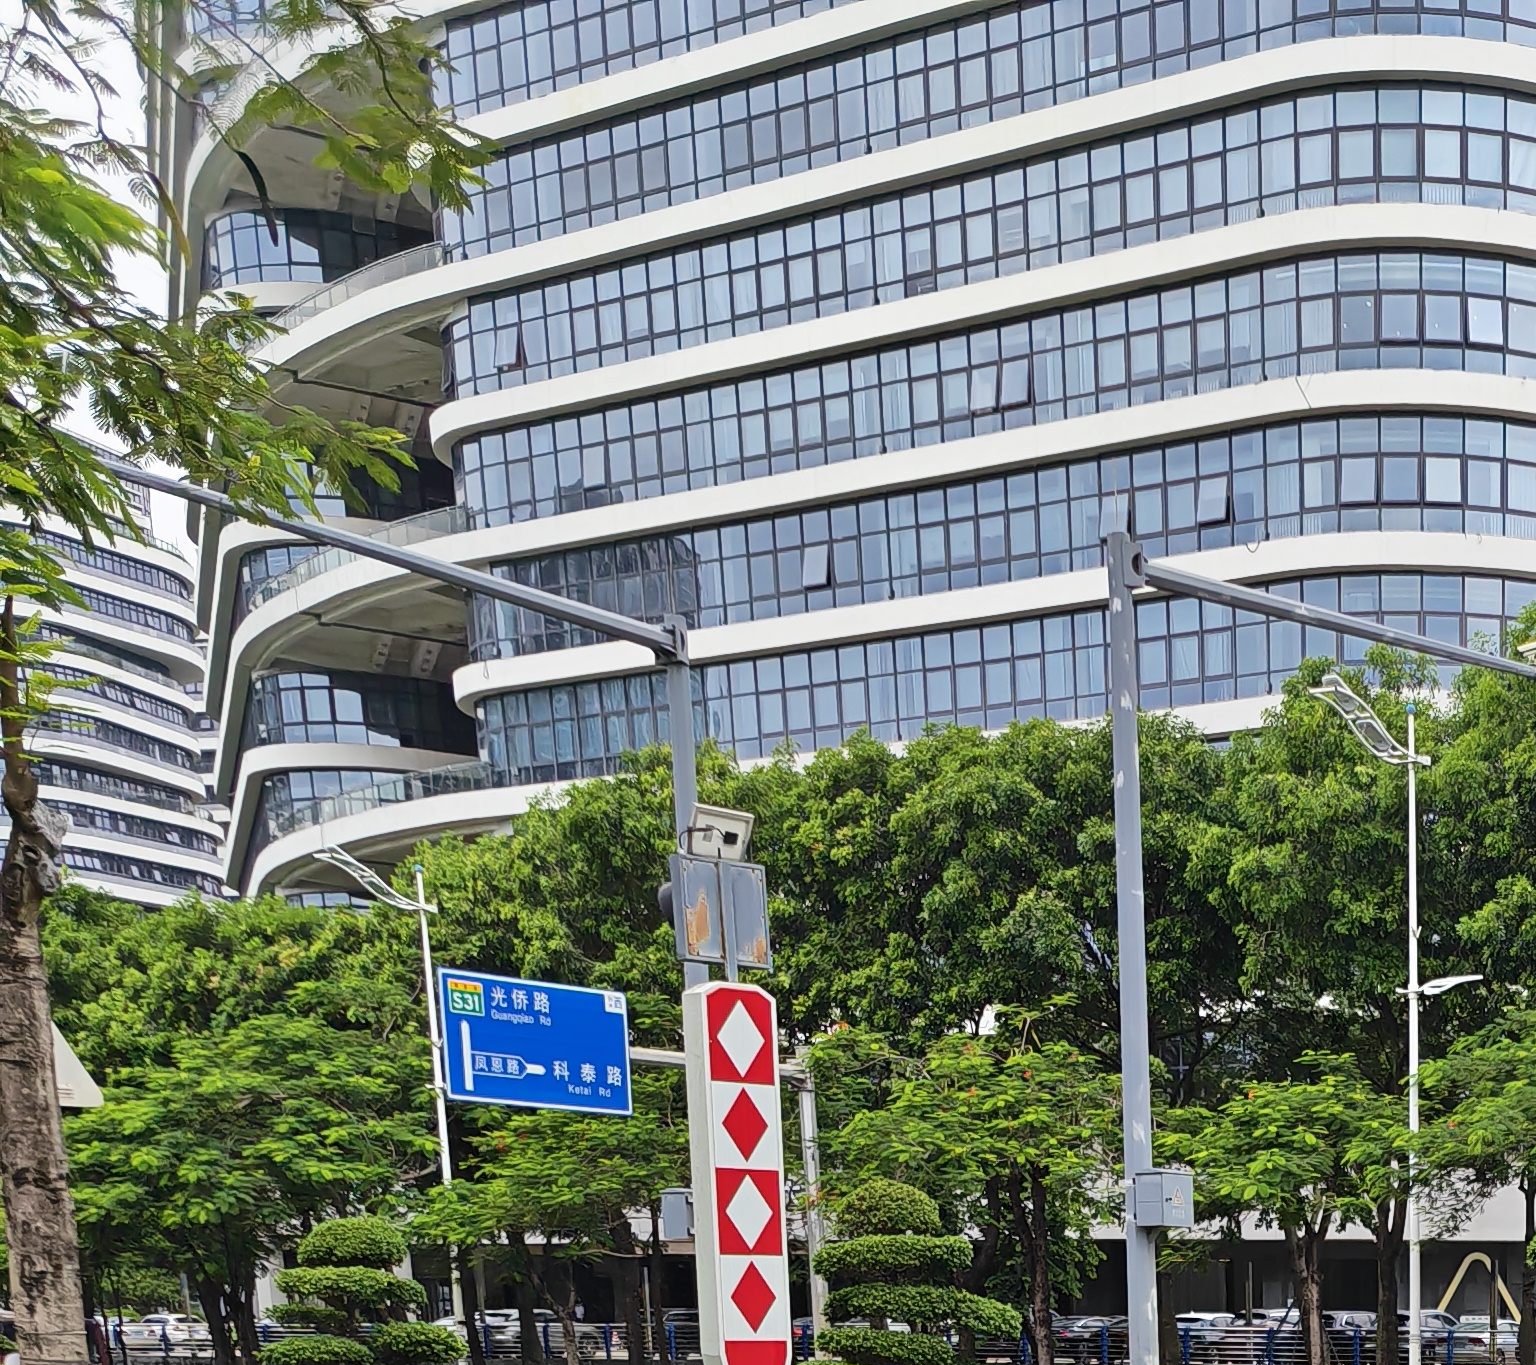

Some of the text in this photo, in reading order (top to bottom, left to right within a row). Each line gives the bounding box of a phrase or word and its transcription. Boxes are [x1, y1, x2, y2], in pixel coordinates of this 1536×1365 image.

[452, 991, 480, 1012] S31
[490, 985, 551, 1014] 光侨路
[490, 1008, 552, 1027] Guangqiao Rd
[552, 1060, 623, 1087] 科泰路
[567, 1083, 612, 1098] Ketai Rd
